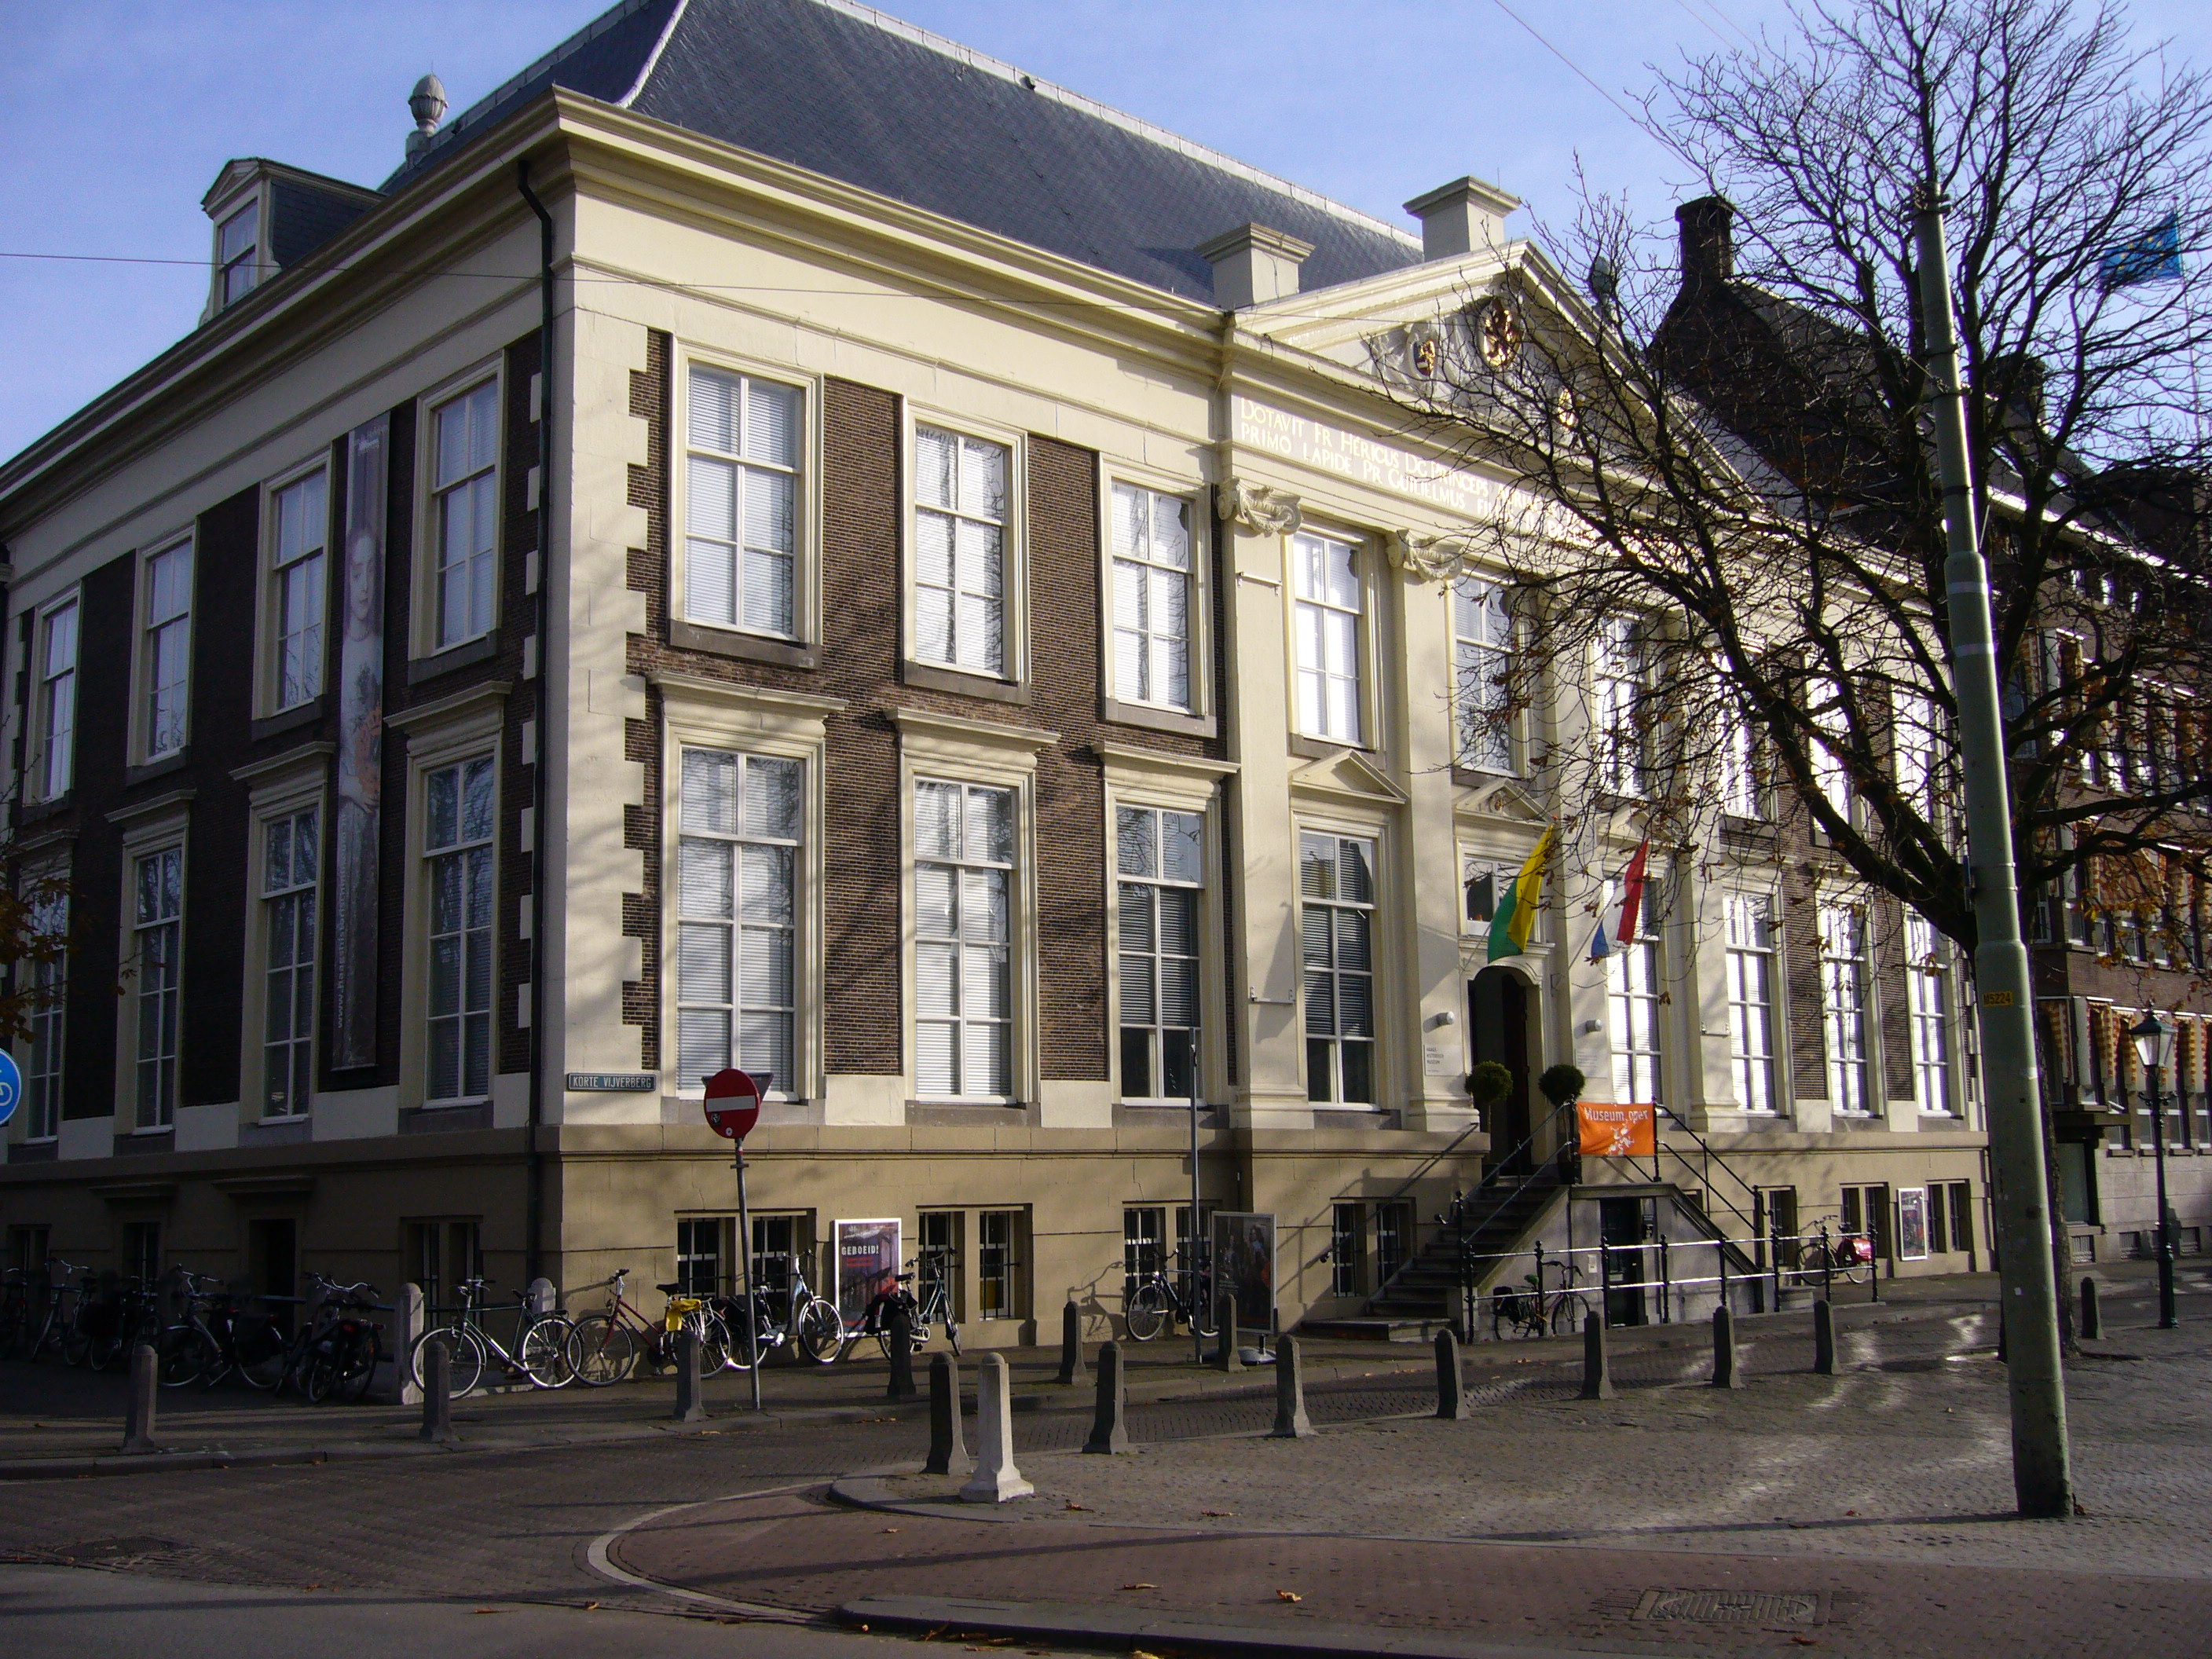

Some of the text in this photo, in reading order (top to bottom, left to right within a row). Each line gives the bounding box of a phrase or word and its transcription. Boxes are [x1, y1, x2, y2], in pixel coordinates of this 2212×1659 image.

[1241, 397, 1304, 438] DOTAVIT
[1241, 423, 1291, 454] PRIMO
[1303, 443, 1352, 474] LAPIDE
[573, 1076, 651, 1088] KORTE VIJVERBERG
[1584, 1107, 1624, 1121] Museum
[841, 1245, 879, 1255] GEBOEID!
